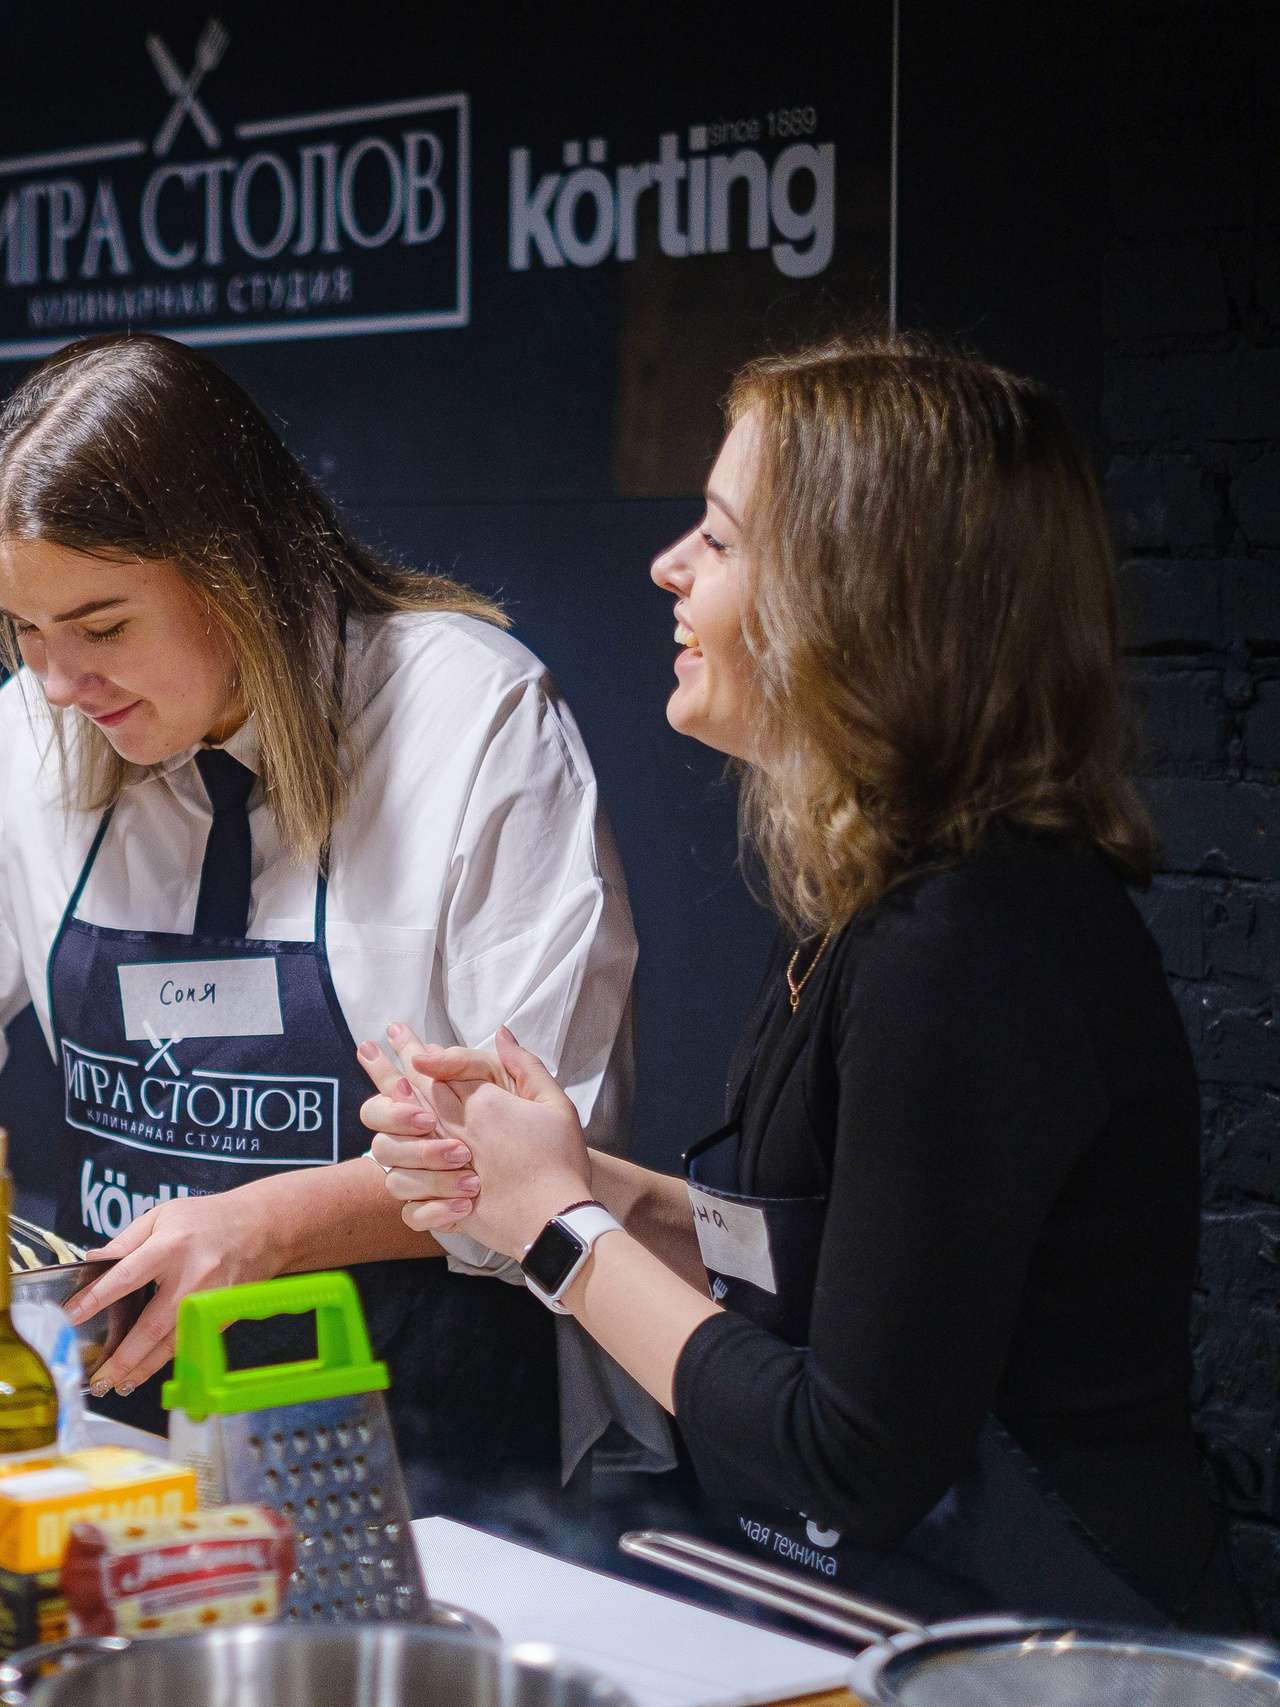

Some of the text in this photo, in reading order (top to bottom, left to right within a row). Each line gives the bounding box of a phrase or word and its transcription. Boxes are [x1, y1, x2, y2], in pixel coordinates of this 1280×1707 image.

[708, 105, 817, 145] since 1889
[140, 131, 446, 269] СТОЛОВ
[509, 125, 836, 278] körting
[227, 266, 354, 314] СТУДИЯ
[160, 980, 216, 1005] Соня
[68, 1059, 323, 1132] ИГРА СТОЛОВ
[86, 1109, 261, 1152] КУЛИНАРНАЯ СТУДИЯ
[773, 1532, 837, 1576] техника
